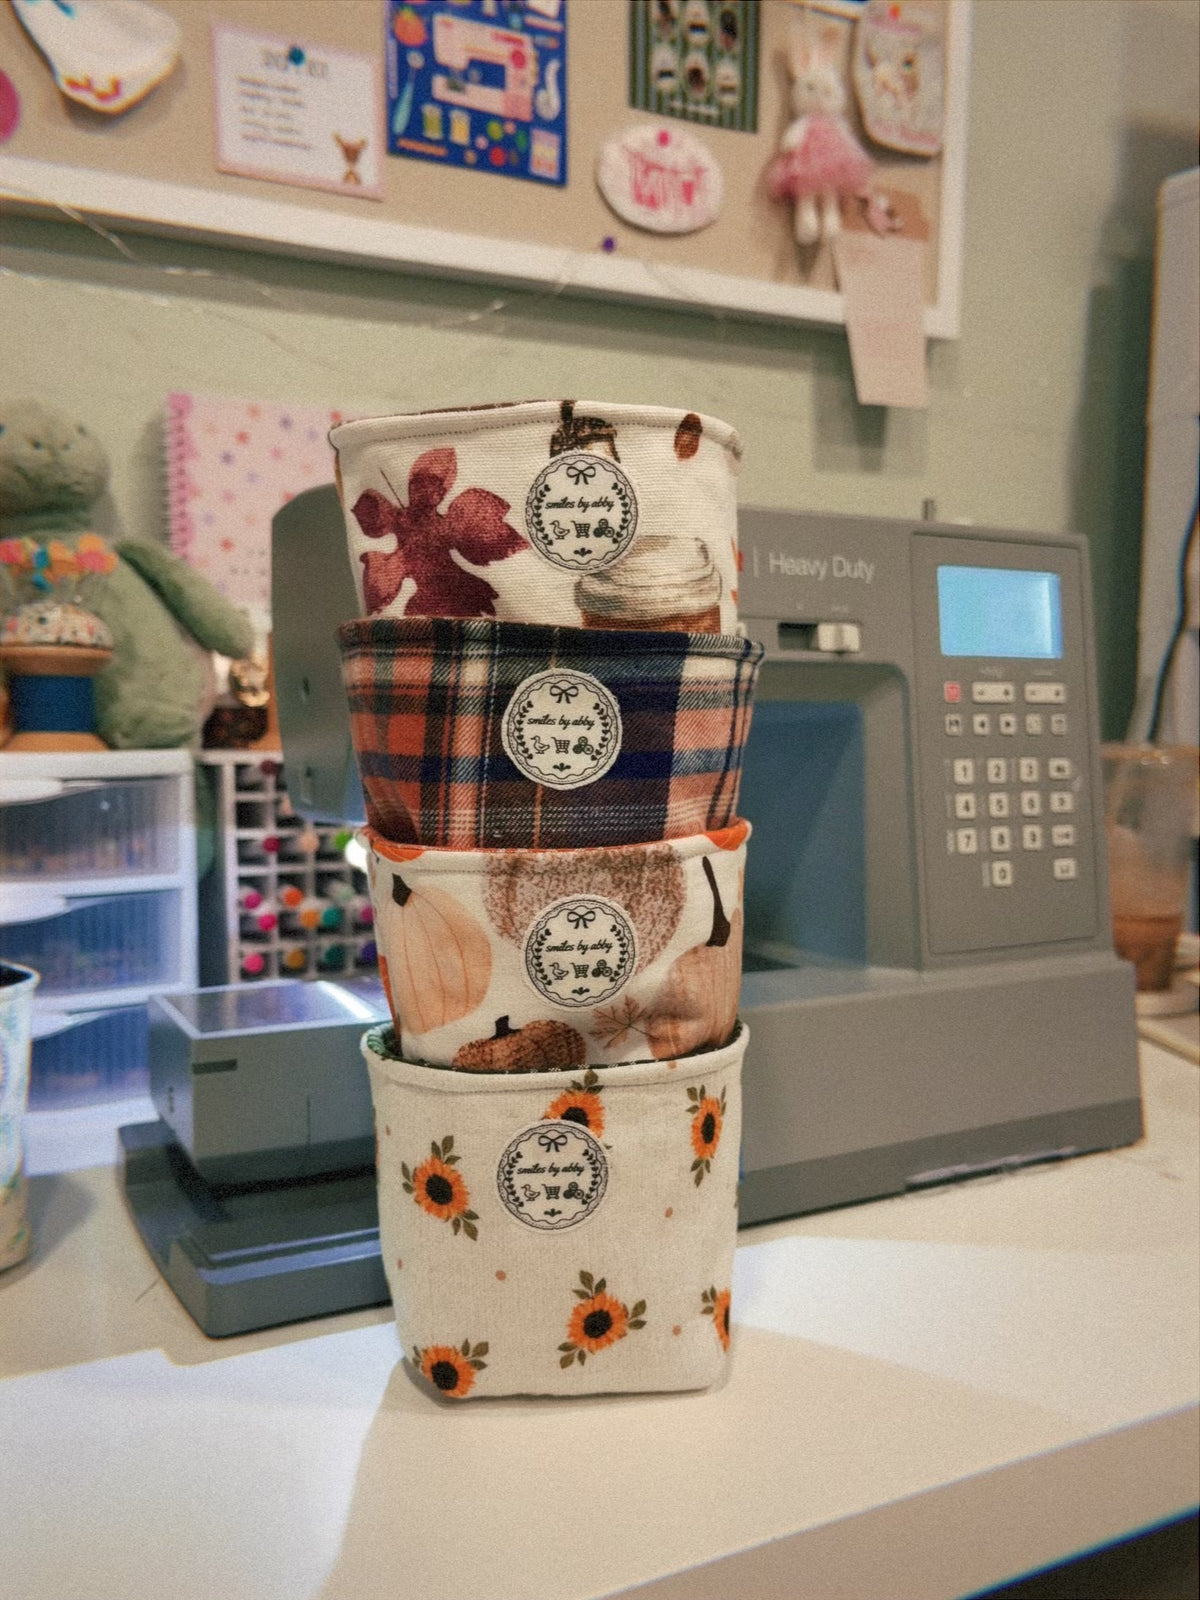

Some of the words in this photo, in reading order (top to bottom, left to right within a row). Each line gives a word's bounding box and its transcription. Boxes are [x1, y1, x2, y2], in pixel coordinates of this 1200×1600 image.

[545, 496, 576, 509] smiles
[577, 496, 590, 513] by
[591, 496, 615, 512] abby
[768, 552, 828, 581] Heavy
[832, 556, 875, 584] Duty
[527, 714, 557, 725] smiles
[558, 714, 571, 730] by
[571, 715, 595, 731] abby
[546, 940, 575, 952] smiles
[576, 939, 589, 955] by
[590, 938, 613, 954] abby
[517, 1162, 546, 1174] smiles
[547, 1162, 560, 1177] by
[561, 1162, 585, 1176] abby
